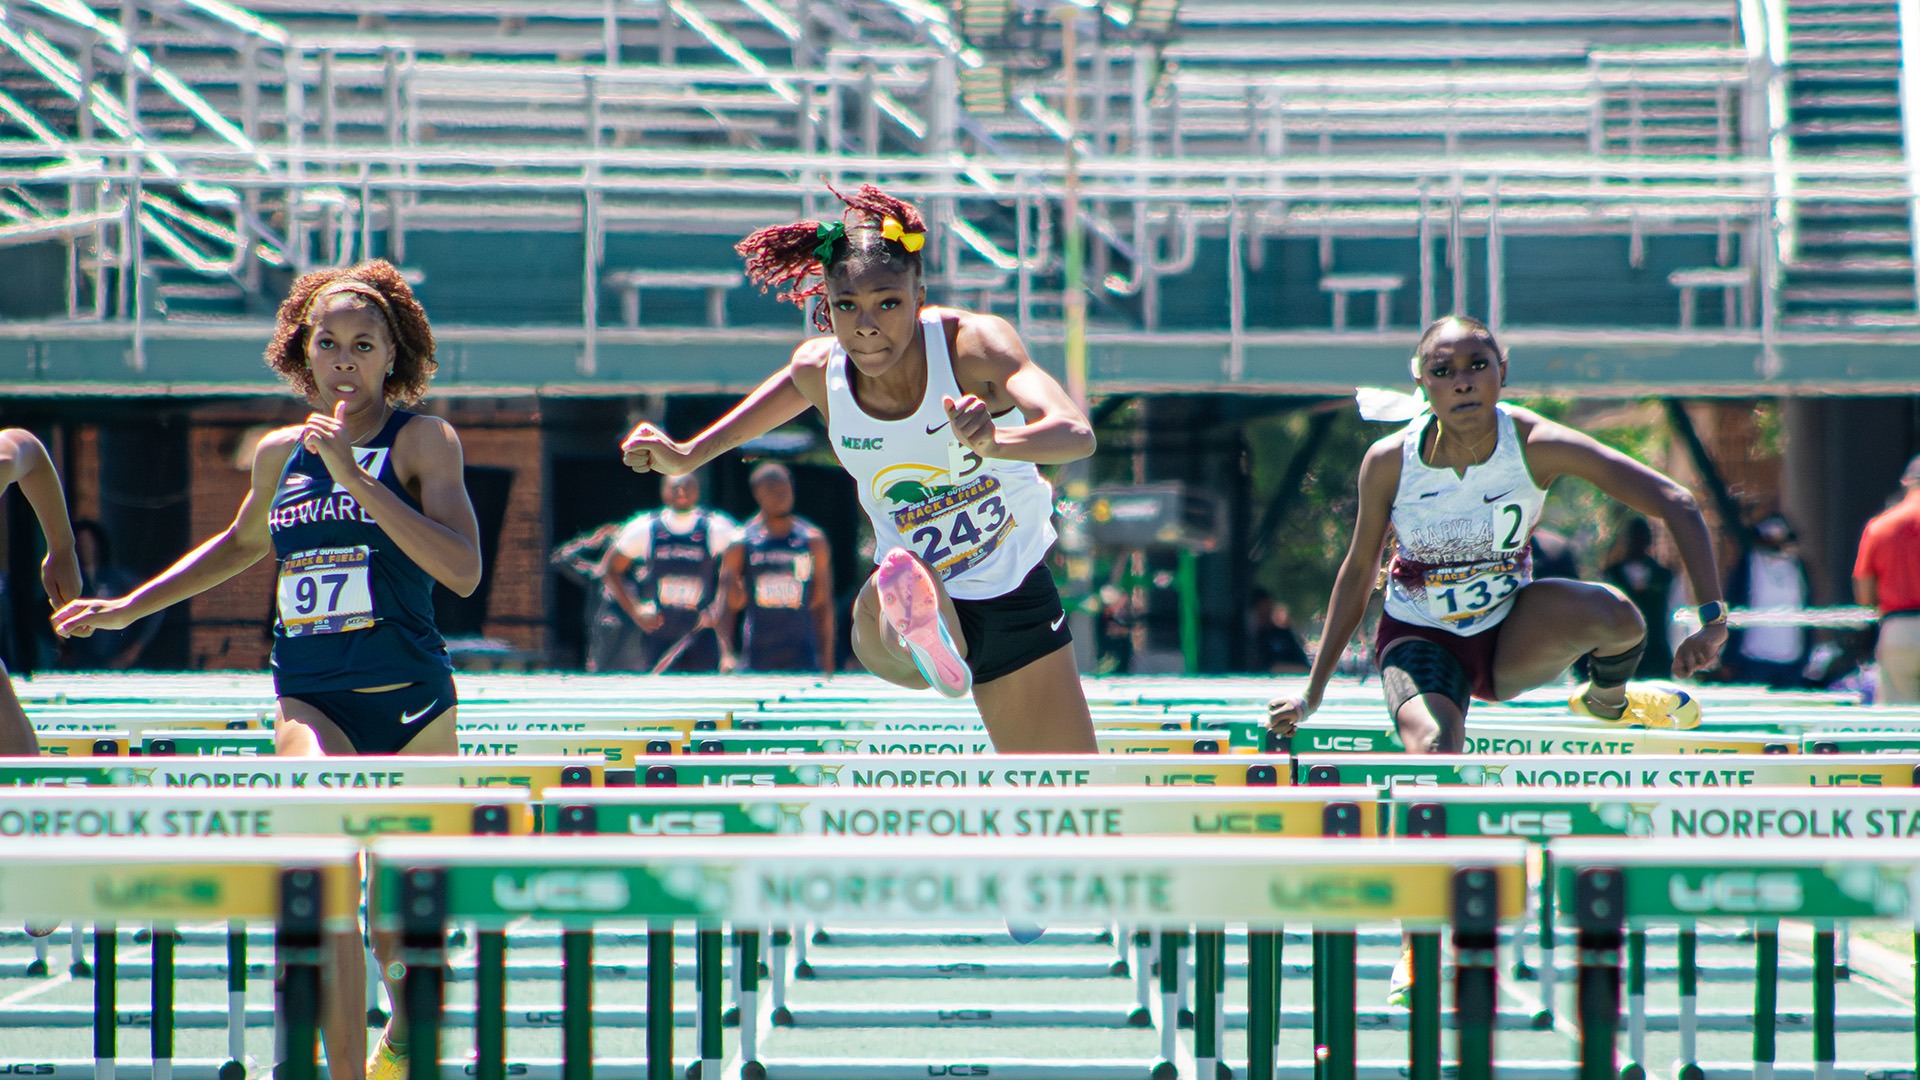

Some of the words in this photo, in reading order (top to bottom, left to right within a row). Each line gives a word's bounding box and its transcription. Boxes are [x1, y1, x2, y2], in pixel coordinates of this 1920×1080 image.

[842, 436, 883, 450] MEAC
[947, 478, 980, 495] OUTDOOR
[899, 501, 942, 524] TRACK
[945, 496, 954, 506] &
[958, 479, 994, 501] FIELD
[912, 496, 1006, 564] 243
[1502, 504, 1522, 549] 2
[285, 556, 313, 569] TRACK
[315, 555, 324, 564] &
[329, 553, 365, 563] FIELD
[319, 547, 354, 556] OUTDOOR
[1429, 574, 1467, 582] TRACK
[295, 573, 348, 614] 97
[1436, 573, 1519, 613] 133
[459, 743, 518, 755] TATE
[1313, 736, 1372, 751] UCS
[1464, 737, 1554, 755] ORFOLK
[1562, 741, 1635, 755] STATE
[165, 772, 308, 788] NORFOLK
[318, 772, 404, 788] STATE
[852, 770, 995, 788] NORFOLK
[1004, 770, 1090, 788] STATE
[1366, 774, 1438, 790] UCS
[1515, 770, 1659, 788] NORFOLK
[1669, 770, 1755, 788] STATE
[0, 810, 149, 837] ORFOLK
[162, 810, 272, 837] STATE
[342, 815, 432, 836] UCS
[628, 811, 725, 835] UCS
[821, 809, 1001, 836] NORFOLK
[1015, 809, 1123, 836] STATE
[1192, 811, 1284, 834] UCS
[1477, 811, 1573, 835] UCS
[1671, 809, 1853, 837] NORFOLK
[1865, 809, 1920, 837] STA
[492, 869, 630, 912] UCS
[760, 868, 999, 912] NORFOLK
[1026, 868, 1173, 912] STATE
[1668, 871, 1804, 912] UCS
[927, 1064, 989, 1077] UCS
